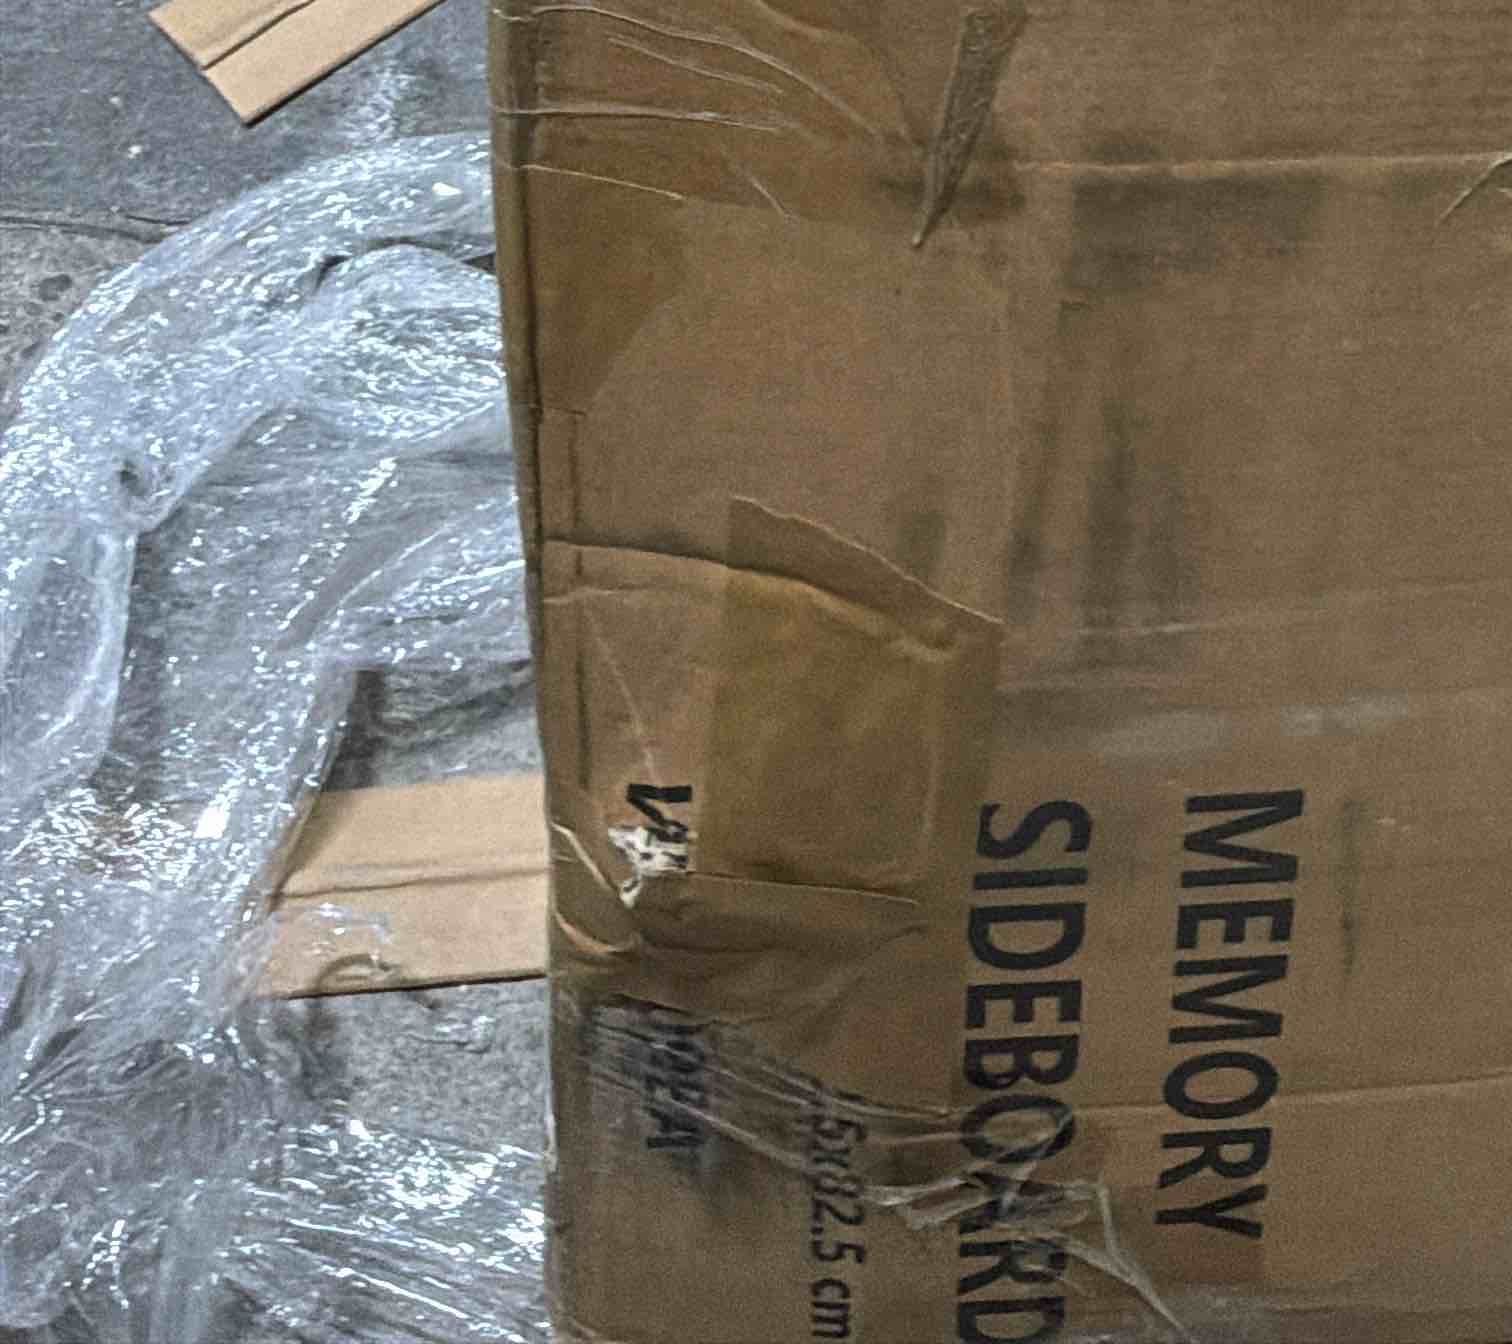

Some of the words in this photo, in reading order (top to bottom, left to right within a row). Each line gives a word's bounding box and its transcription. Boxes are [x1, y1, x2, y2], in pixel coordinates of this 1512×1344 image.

[956, 798, 1094, 1344] SIDEBOARD
[1154, 787, 1306, 1240] MEMORY
[810, 1280, 852, 1341] cm
